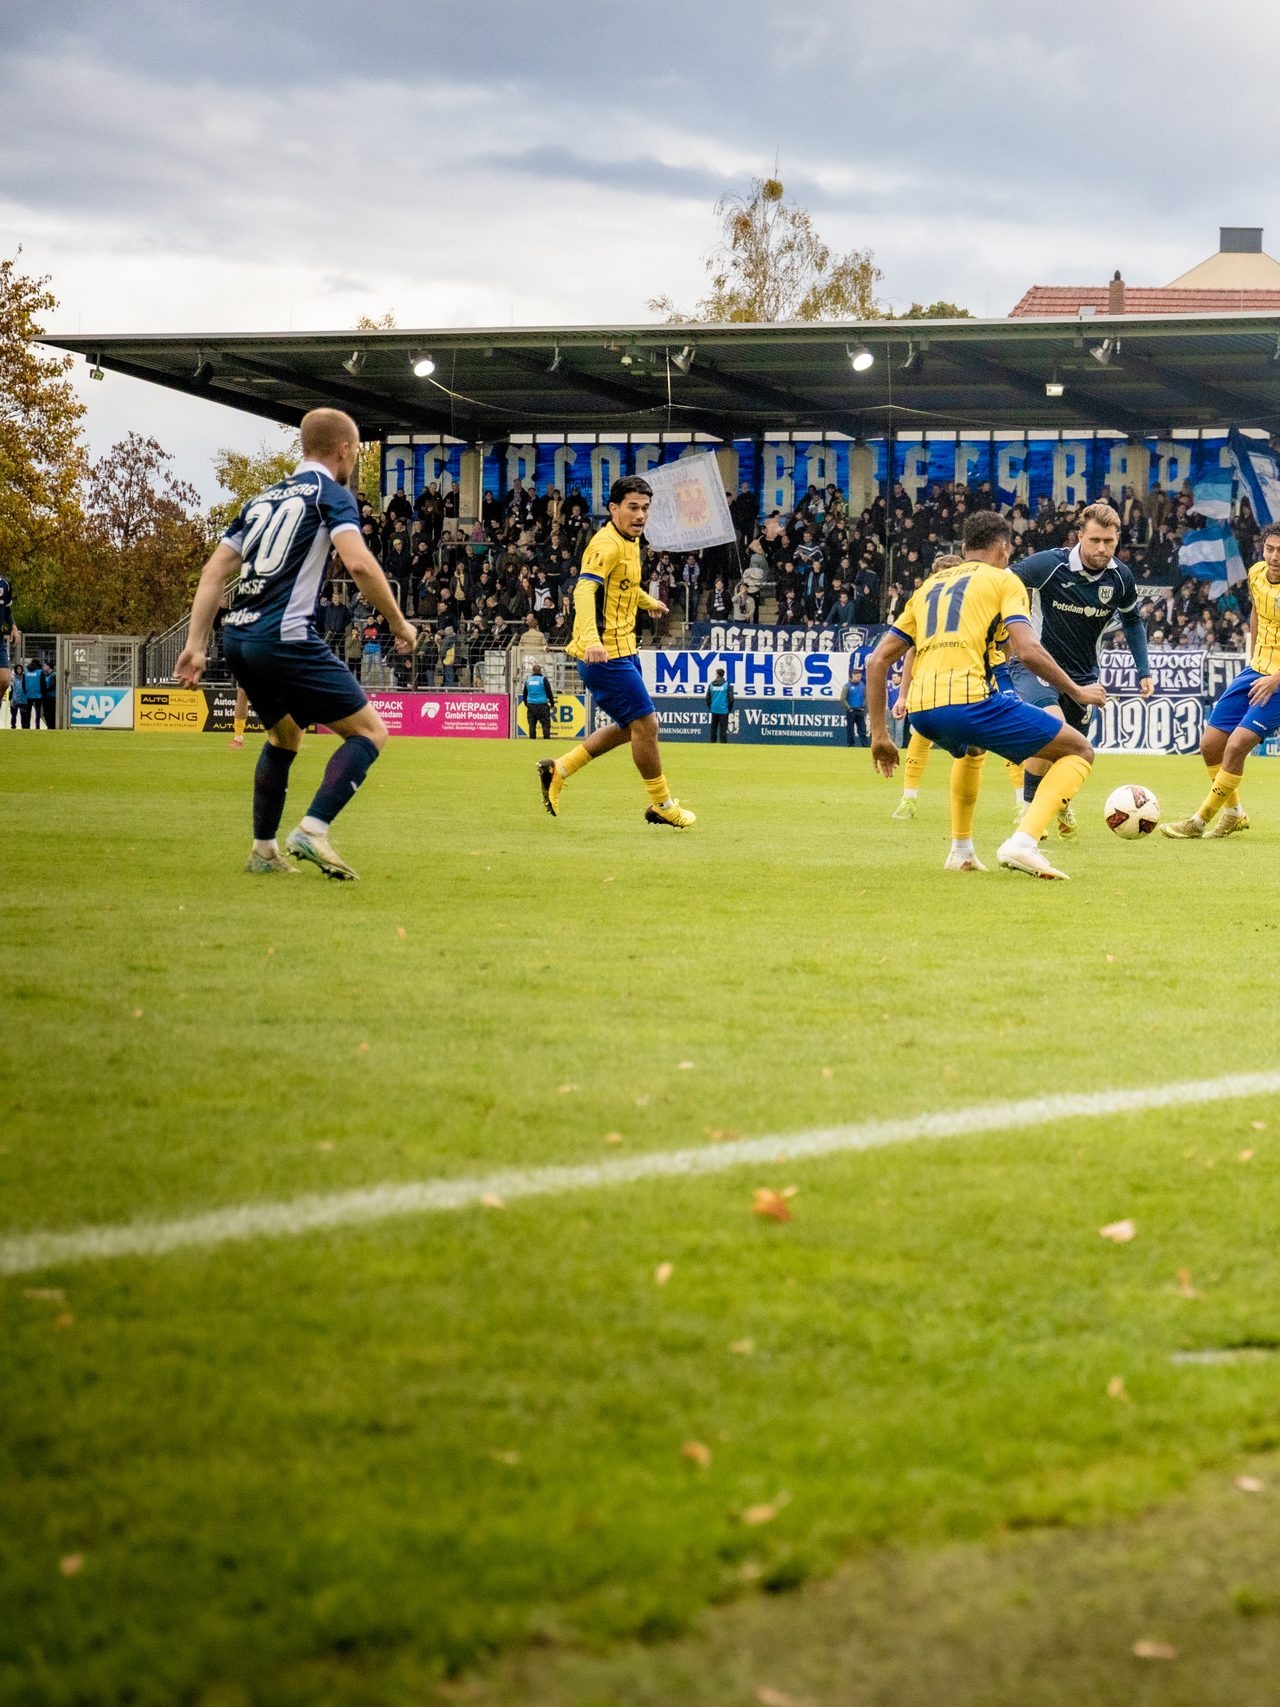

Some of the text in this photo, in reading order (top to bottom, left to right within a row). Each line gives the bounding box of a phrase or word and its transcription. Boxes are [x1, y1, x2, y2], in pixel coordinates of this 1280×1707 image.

[241, 496, 306, 577] 20
[924, 575, 972, 639] 11
[1052, 600, 1084, 615] Potsdam
[1100, 653, 1201, 668] UNDRDOGS
[655, 685, 833, 697] BABSBERG
[72, 695, 115, 719] SAP
[213, 698, 236, 706] Autos
[370, 701, 403, 710] ERPACK
[445, 702, 499, 711] TAVERPACK
[140, 708, 198, 722] KÖNIG
[213, 709, 223, 717] zu
[376, 711, 402, 719] otsdam
[445, 712, 498, 720] GmbH Potsdam
[548, 705, 574, 723] RB
[656, 711, 712, 725] MINSTE
[744, 709, 848, 728] WESTMINSTER
[657, 728, 702, 736] HMENSGRUPPE
[1103, 699, 1200, 751] 1903
